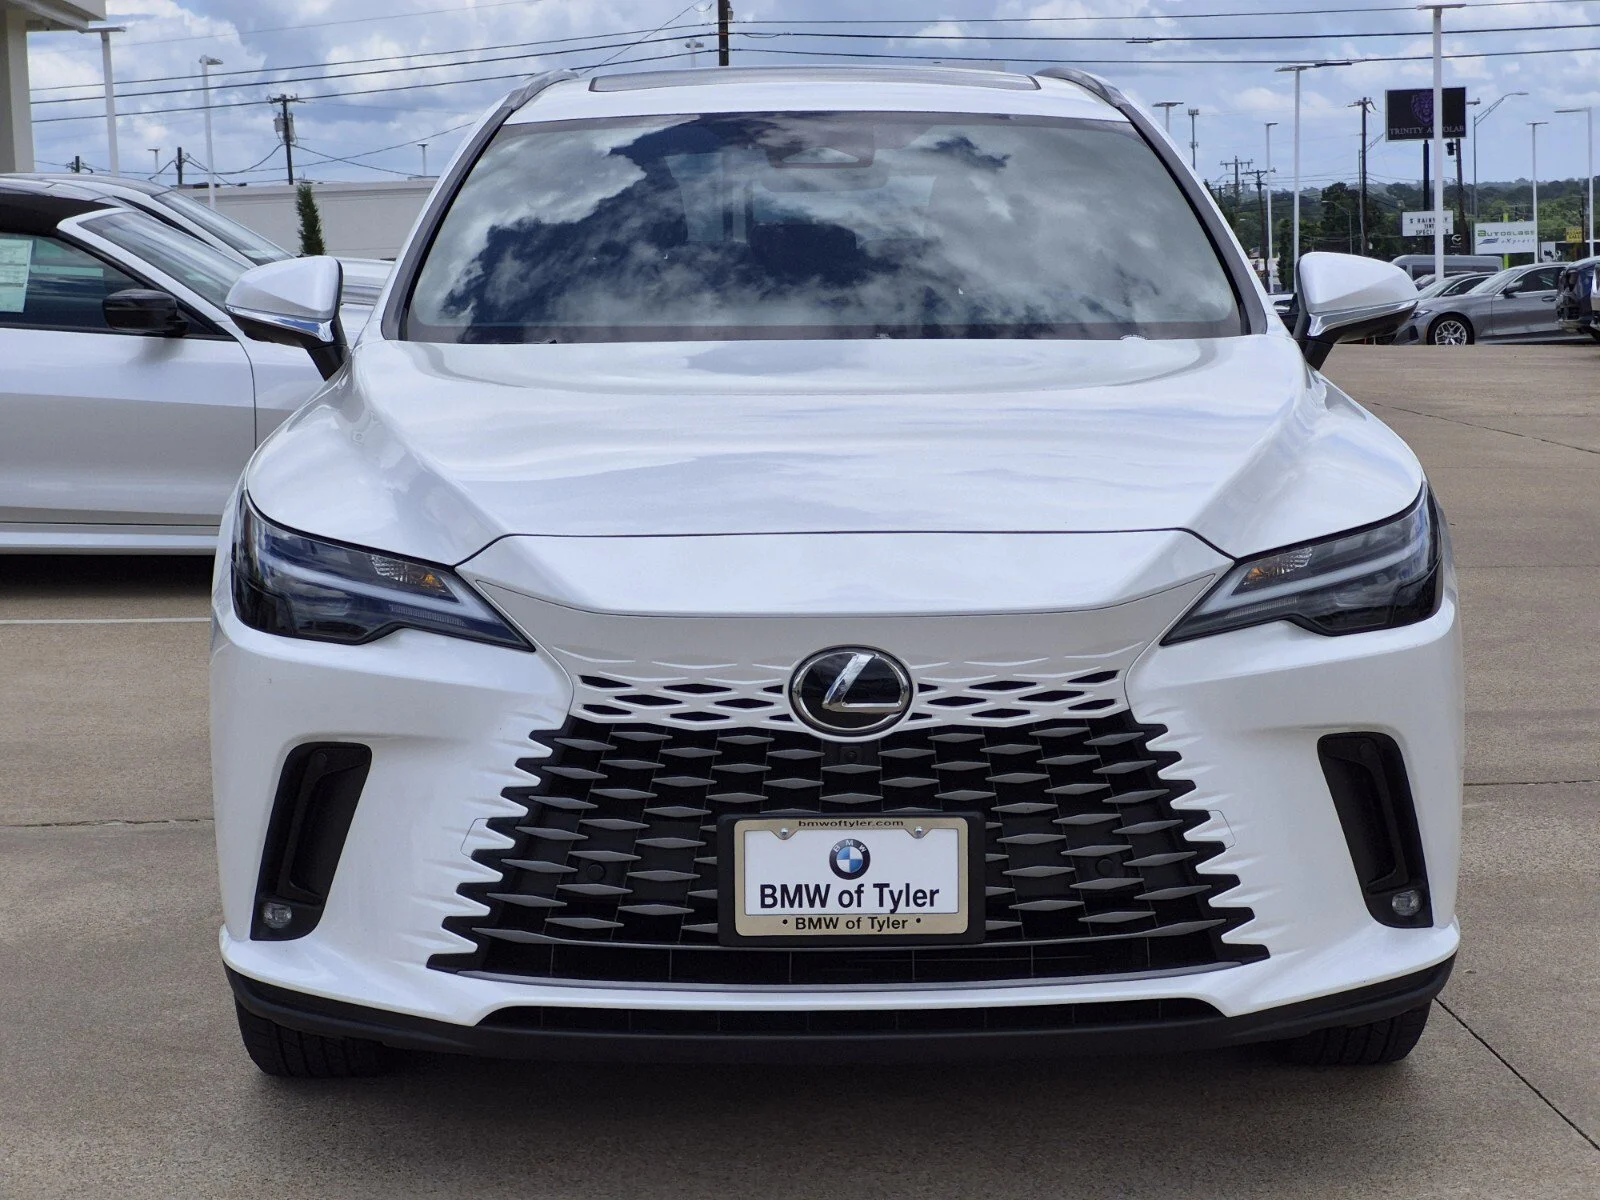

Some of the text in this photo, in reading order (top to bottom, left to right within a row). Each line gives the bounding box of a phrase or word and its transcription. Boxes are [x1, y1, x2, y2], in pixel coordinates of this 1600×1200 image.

[1389, 125, 1464, 135] TRINITY AOLAB
[1415, 228, 1449, 236] SPECIS
[798, 820, 904, 829] bmwoftyler.com
[759, 883, 940, 914] BMW of Tyler
[795, 916, 909, 932] BMW of Tyler
